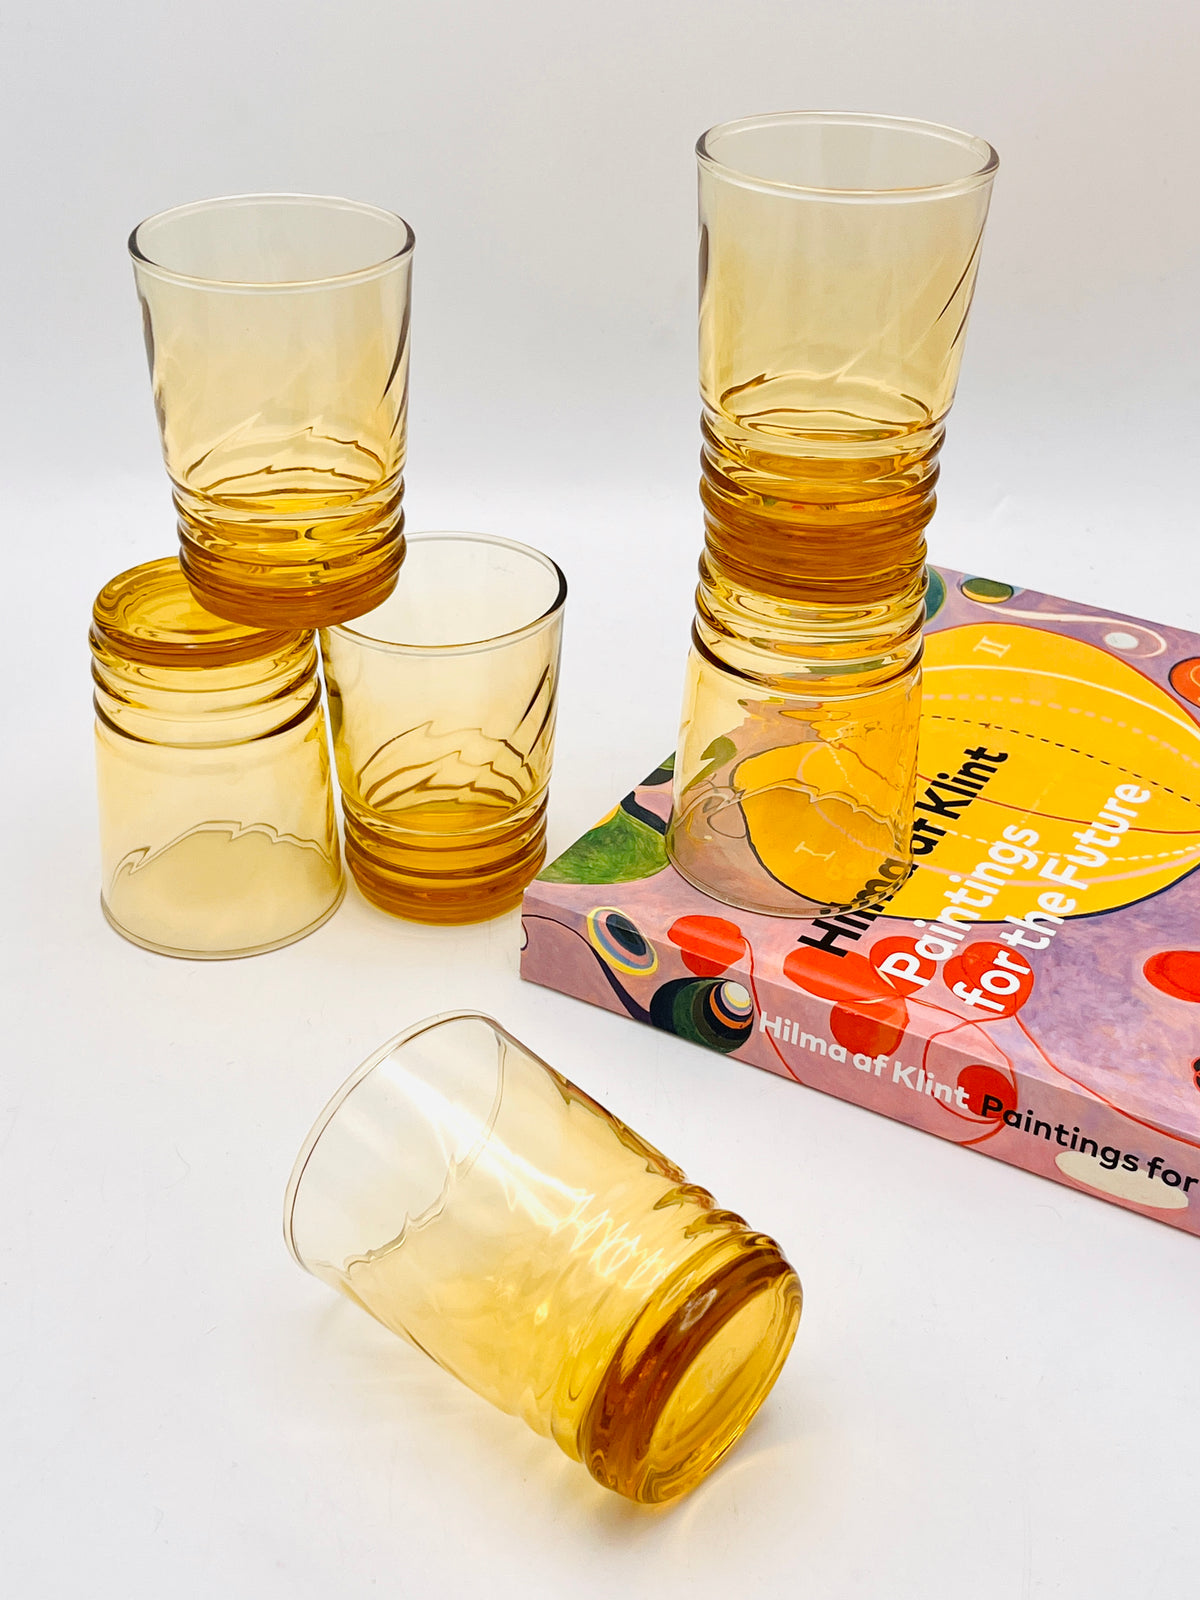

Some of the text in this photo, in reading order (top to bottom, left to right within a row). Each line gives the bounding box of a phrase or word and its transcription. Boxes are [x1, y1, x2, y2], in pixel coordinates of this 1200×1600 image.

[914, 746, 1008, 820] Klint
[879, 824, 1039, 987] Paintings
[953, 783, 1151, 1012] for the Future
[759, 1011, 970, 1109] Hilma af Klint
[981, 1094, 1199, 1192] Paintings for
